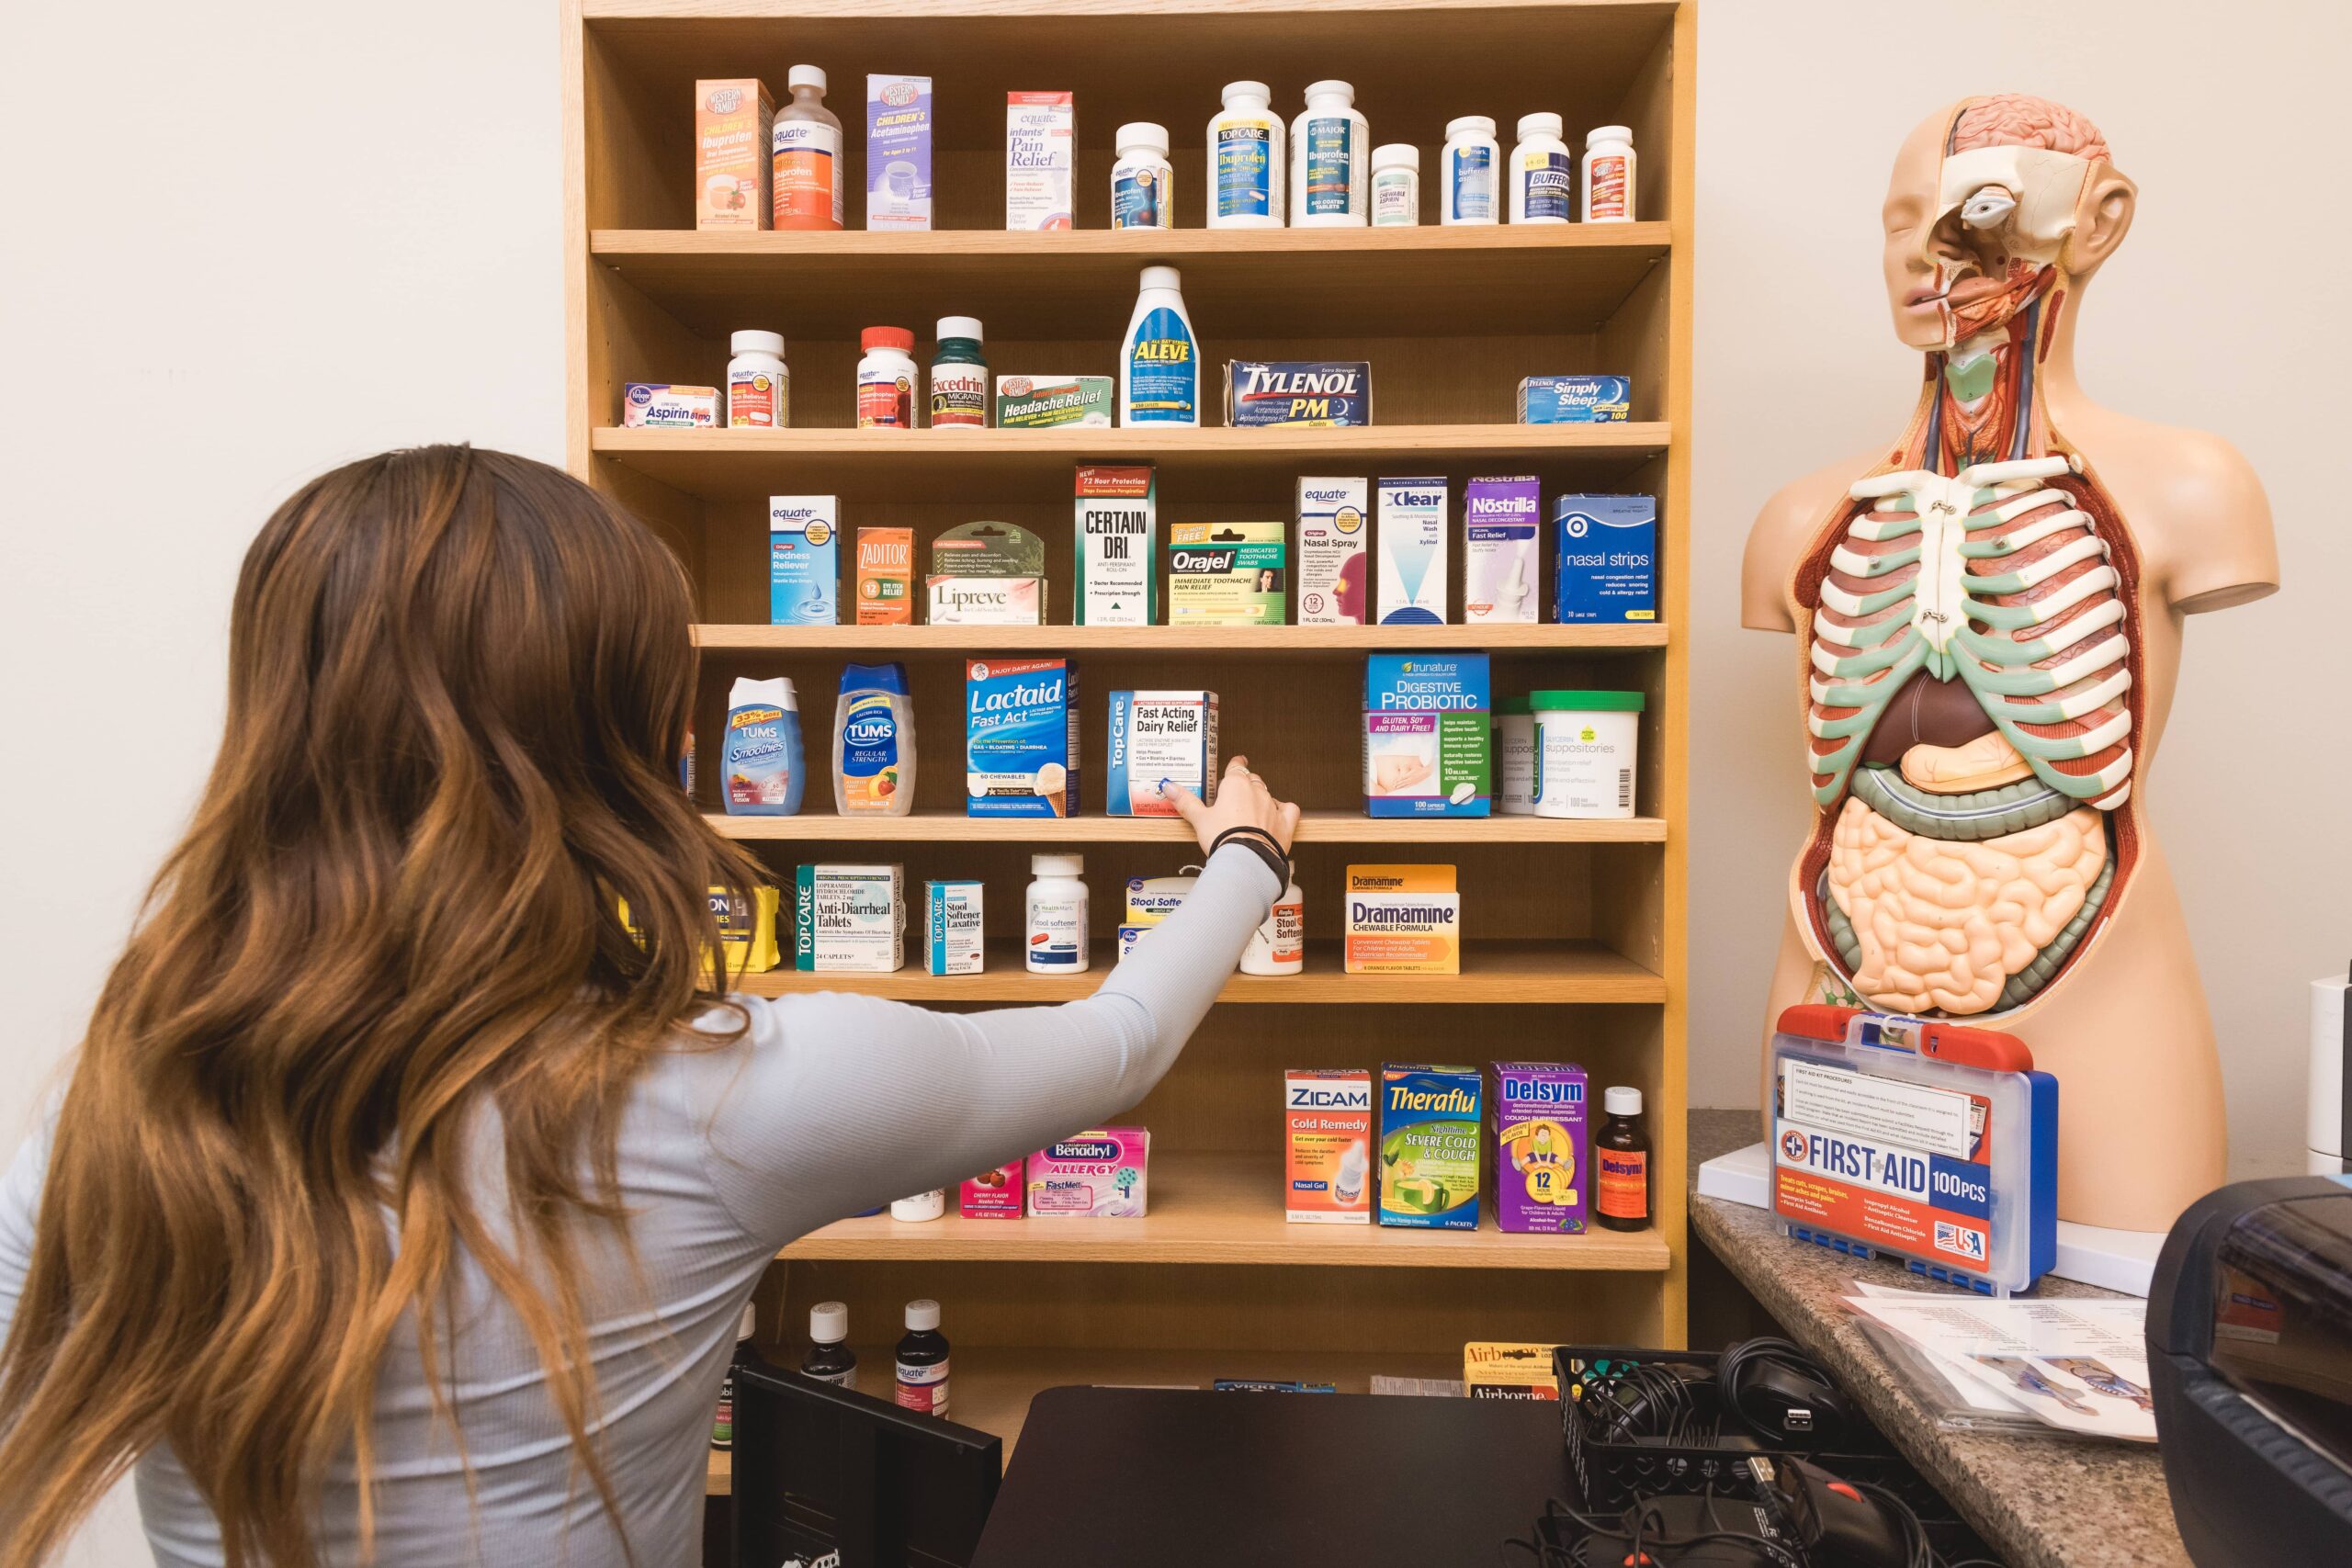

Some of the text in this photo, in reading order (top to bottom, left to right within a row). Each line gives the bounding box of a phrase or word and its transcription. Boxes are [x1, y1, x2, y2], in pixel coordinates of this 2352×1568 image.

[885, 85, 915, 97] WESTERN
[714, 99, 737, 114] FAMILY
[888, 95, 910, 107] FAMILY
[876, 111, 925, 127] CHILDREN'S
[1021, 115, 1056, 125] equate
[774, 128, 808, 143] equate
[871, 122, 930, 139] Acetaminophen
[1010, 128, 1046, 137] infants'
[1220, 129, 1264, 141] TOP CARE
[702, 131, 752, 149] Ibuprofen
[1010, 138, 1044, 152] Pain
[1010, 152, 1057, 166] Relief
[1219, 152, 1266, 166] Ibuprofen
[1308, 152, 1349, 163] Ibuprofen
[1135, 341, 1190, 361] ALEVE
[932, 377, 983, 394] Excedrin
[1242, 367, 1358, 395] TYLENOL
[1528, 379, 1555, 388] TYLENOL
[1554, 381, 1601, 396] Simply
[947, 393, 983, 401] MIGRAINE
[1004, 397, 1063, 418] Headache
[1066, 389, 1102, 407] Relief
[1558, 394, 1598, 408] Sleep
[646, 407, 689, 421] Aspirin
[1254, 406, 1289, 415] Acetaminophen
[1288, 399, 1329, 418] PM
[1305, 490, 1347, 502] equate
[1385, 491, 1442, 507] Xlear
[773, 508, 812, 520] equate
[1085, 511, 1147, 535] CERTAIN
[1176, 531, 1204, 542] FREE!
[1103, 536, 1128, 559] DRI
[1304, 539, 1358, 549] Nasal Spray
[773, 551, 810, 559] Redness
[860, 543, 909, 569] ZADITOR
[1172, 551, 1231, 573] Orajel
[1566, 551, 1649, 570] nasal strips
[773, 561, 808, 570] Reliever
[865, 584, 876, 594] 12
[937, 586, 1007, 612] Lipreve
[1412, 662, 1457, 672] trunature
[1396, 681, 1462, 694] DIGESTIVE
[970, 679, 1062, 714] Lactaid
[1381, 692, 1477, 710] PROBIOTIC
[970, 710, 1028, 728] Fast Act
[1137, 707, 1194, 721] Fast Acting
[1382, 716, 1424, 725] GLUTEN, SOY
[741, 727, 778, 739] TUMS
[848, 725, 893, 739] TUMS
[1112, 700, 1125, 769] TopCare
[1136, 720, 1198, 735] Dairy Relief
[1390, 724, 1410, 732] DAIRY
[1411, 724, 1430, 732] FREE!
[730, 740, 785, 761] Smoothies
[1545, 743, 1615, 756] suppositories
[1352, 875, 1404, 887] Dramamine
[816, 902, 891, 916] Anti-Diarrheal
[946, 903, 967, 911] Stool
[1130, 897, 1182, 907] Stool Softe
[946, 911, 980, 920] Softener
[1352, 902, 1454, 924] Dramamine
[816, 915, 852, 928] Tablets
[946, 919, 980, 929] Laxative
[1276, 918, 1296, 928] Stool
[1352, 923, 1433, 931] CHEWABLE FORMULA
[1276, 928, 1303, 939] Softene
[1505, 1079, 1582, 1102] Delsym
[1291, 1089, 1368, 1107] ZICAM
[1389, 1087, 1476, 1113] Theraflu
[1291, 1118, 1368, 1133] Cold Remedy
[1430, 1124, 1467, 1135] Nighttime
[1405, 1133, 1476, 1149] SEVERE COLD
[1055, 1144, 1111, 1159] Benadryl
[1423, 1148, 1476, 1162] & COUGH
[1051, 1164, 1117, 1176] ALLERGY
[1809, 1134, 1926, 1193] FIRST AID
[1046, 1180, 1081, 1191] FastMelt
[1295, 1181, 1325, 1190] Nasal Gel
[1534, 1172, 1551, 1188] 12
[1954, 1226, 1983, 1256] USA
[897, 1366, 925, 1378] equate
[1474, 1388, 1546, 1400] Airborne
